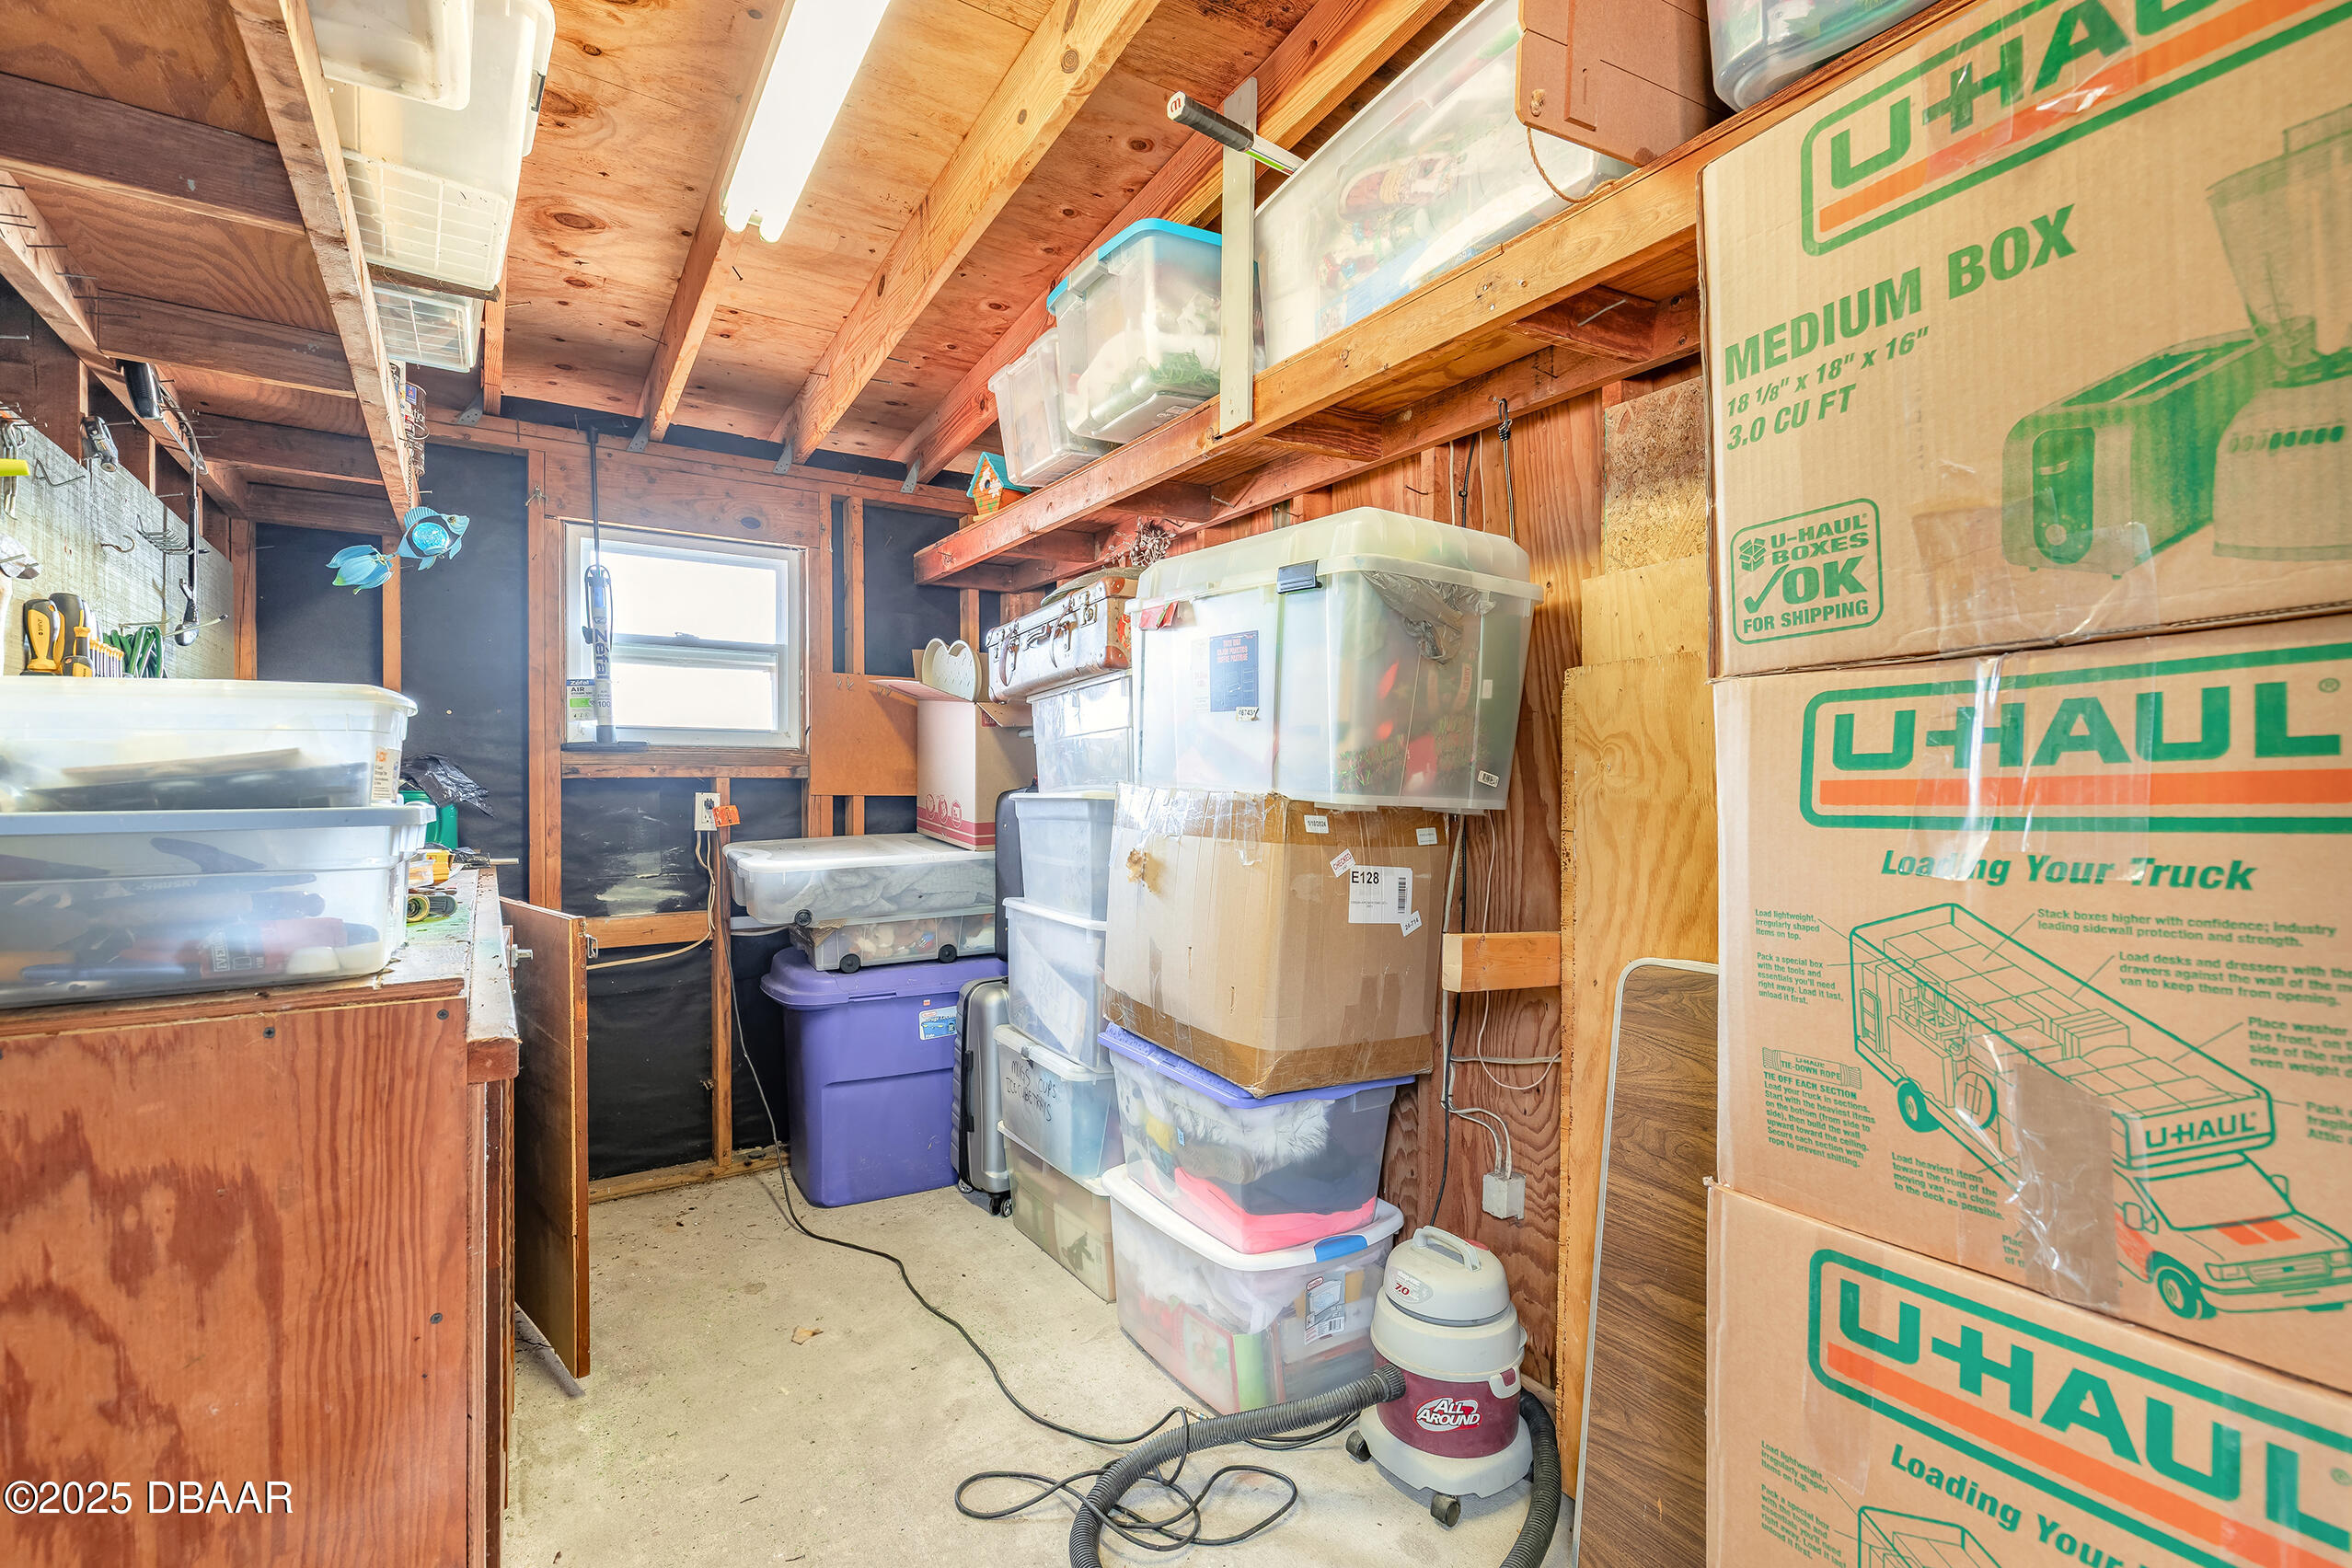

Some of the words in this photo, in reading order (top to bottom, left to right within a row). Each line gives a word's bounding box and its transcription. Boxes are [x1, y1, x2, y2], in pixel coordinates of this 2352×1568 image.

[1724, 266, 1921, 386] MEDIUM
[1947, 203, 2077, 301] BOX
[1726, 393, 1750, 418] 18
[1816, 352, 1855, 385] 18"
[1885, 326, 1930, 360] 16"
[1726, 416, 1767, 451] 3.0
[1773, 398, 1811, 435] CU
[1817, 383, 1857, 421] FT
[1772, 532, 1869, 566] BOXES
[1781, 555, 1868, 605] OK
[1743, 616, 1775, 634] FOR
[1781, 599, 1869, 628] SHIPPING
[594, 628, 609, 680] Zéfal
[1332, 853, 1353, 871] CHECKED
[1351, 870, 1380, 884] E128
[2026, 854, 2116, 885] Your
[2129, 857, 2258, 892] Truck
[1037, 1078, 1057, 1099] CUPS
[1394, 1282, 1410, 1296] 7.0
[1416, 1408, 1481, 1426] AROUND
[1433, 1399, 1464, 1414] ALL
[1891, 1443, 2022, 1533] Loading
